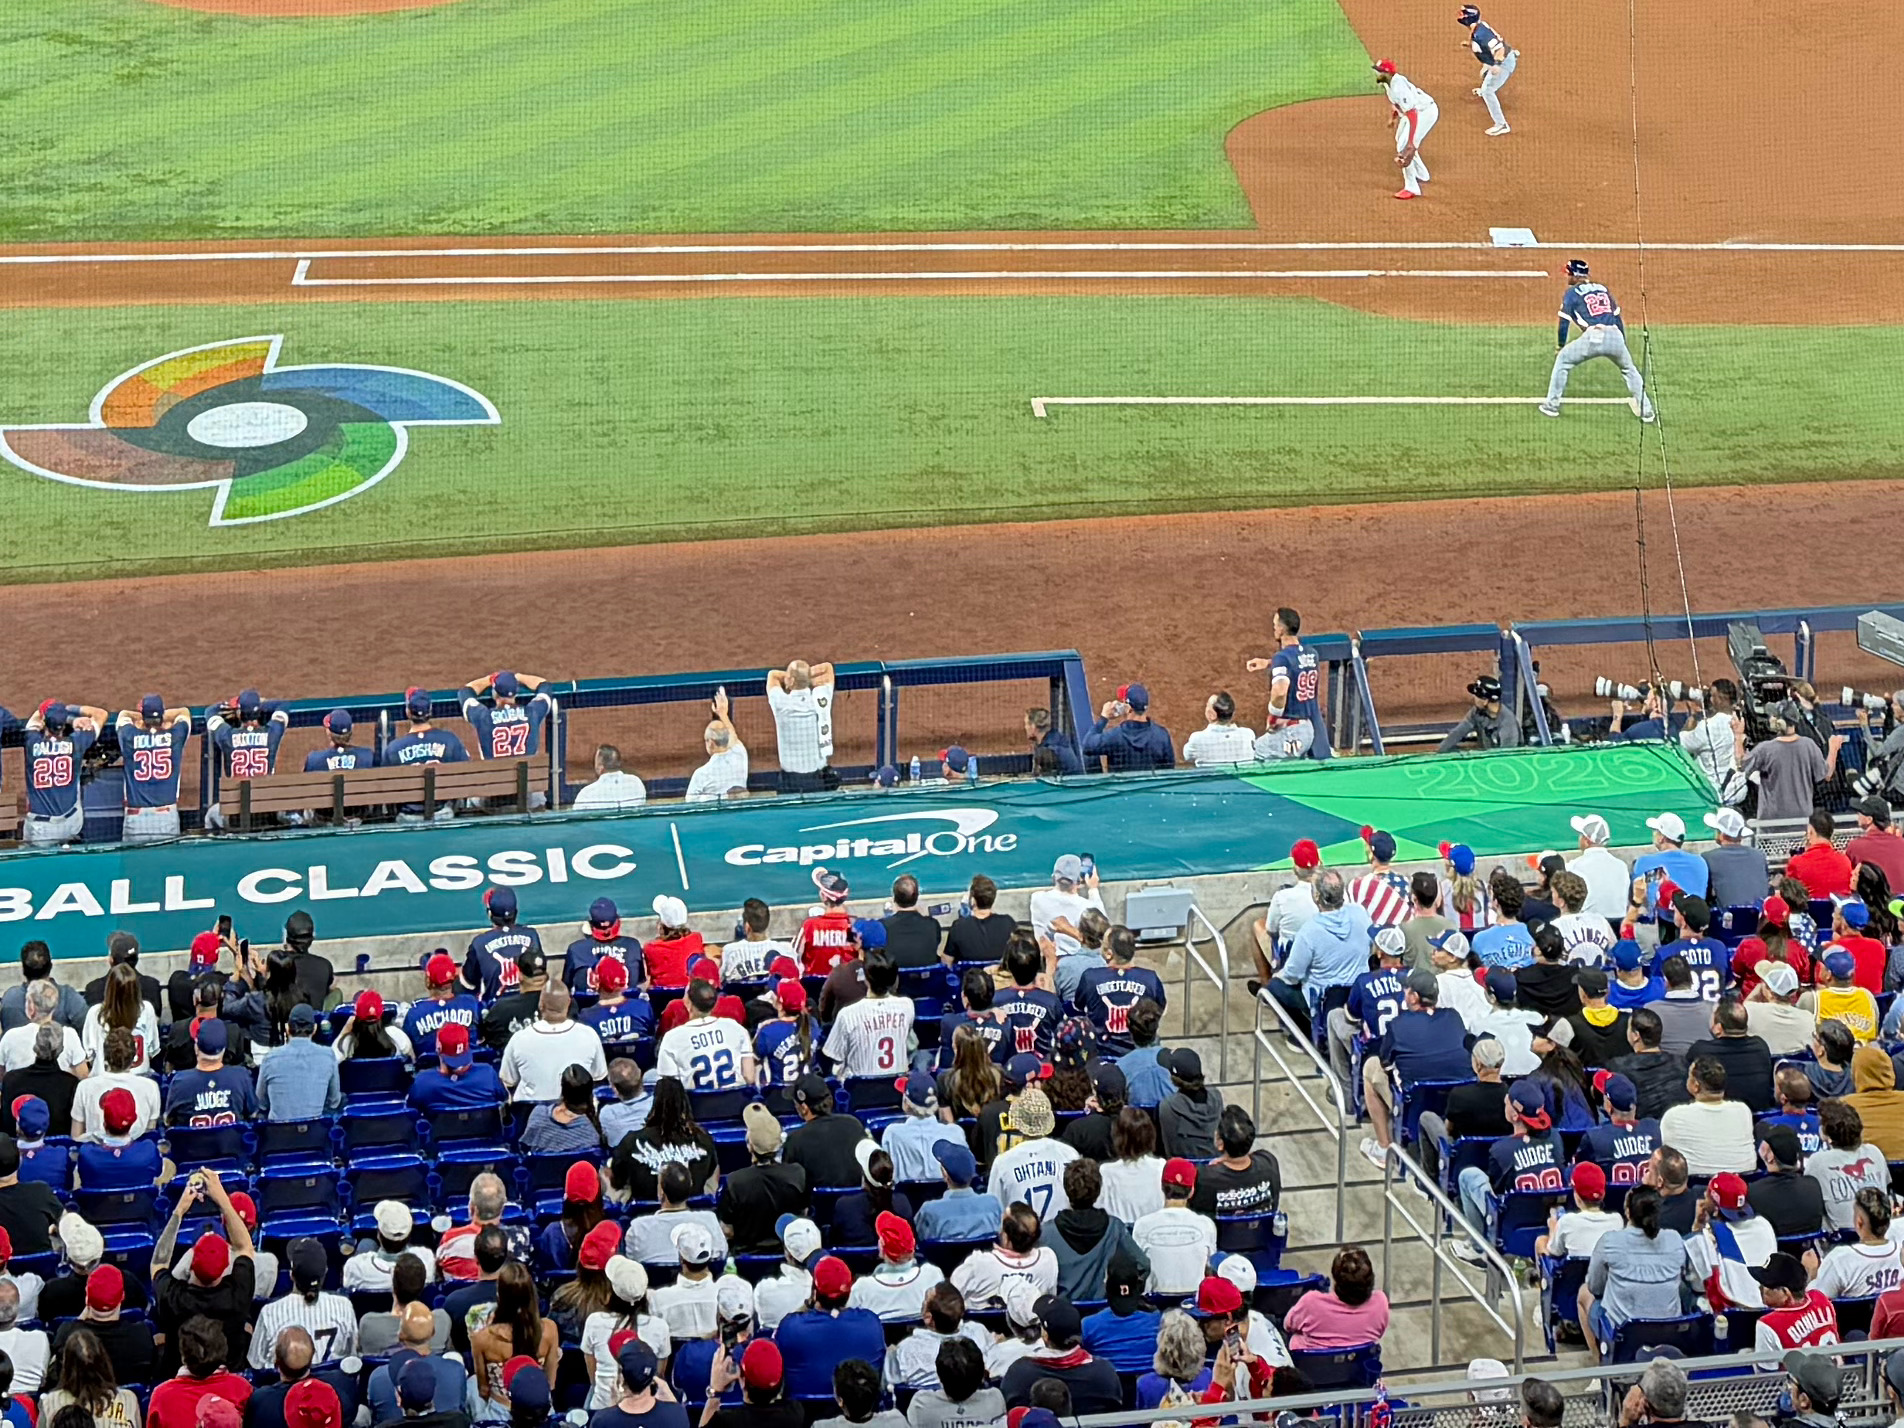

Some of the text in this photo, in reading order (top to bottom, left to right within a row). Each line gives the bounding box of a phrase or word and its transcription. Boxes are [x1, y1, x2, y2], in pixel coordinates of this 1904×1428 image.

[492, 723, 530, 757] 27
[33, 755, 74, 788] 29
[134, 748, 172, 781] 35
[230, 747, 268, 778] 25
[1404, 744, 1663, 800] 2026
[237, 842, 636, 904] CLASSIC
[599, 1017, 631, 1038] SOTO
[863, 1012, 906, 1034] HARPER
[690, 1029, 725, 1050] SOTO
[878, 1036, 895, 1070] 3
[690, 1049, 737, 1091] 22
[194, 1090, 232, 1111] JUDGE
[1513, 1143, 1555, 1172] JUDGE
[1612, 1135, 1653, 1160] JUDGE
[1014, 1161, 1056, 1183] OHTANI
